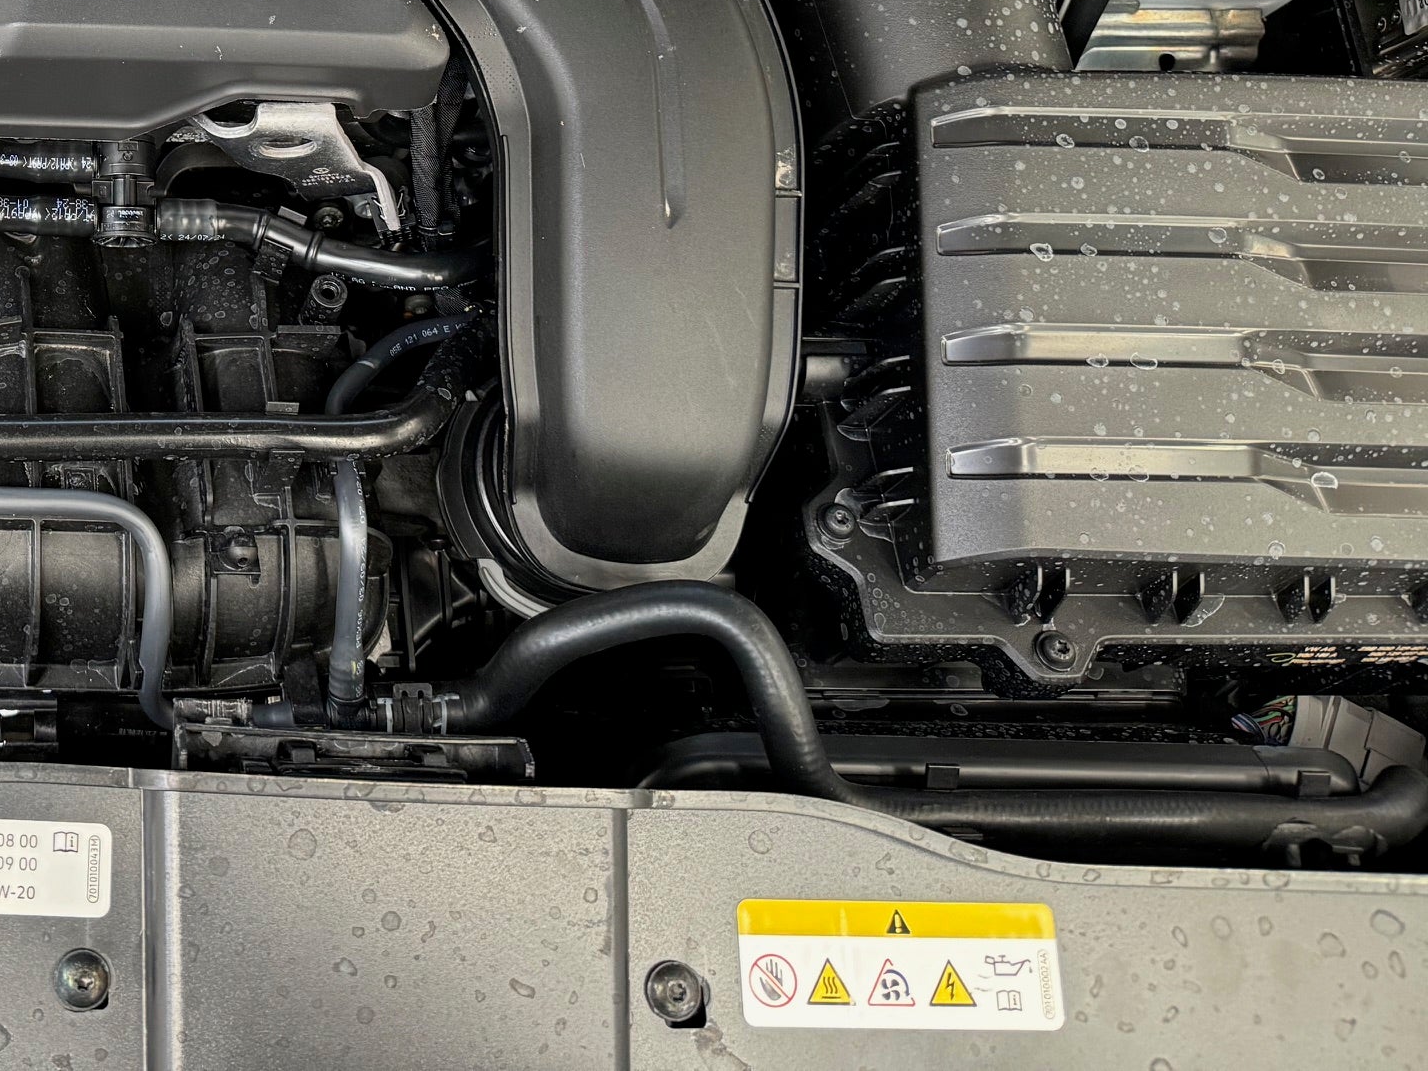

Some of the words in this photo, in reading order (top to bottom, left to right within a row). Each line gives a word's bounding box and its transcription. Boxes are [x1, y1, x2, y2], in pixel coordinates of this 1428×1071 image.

[404, 333, 419, 345] 121
[421, 327, 439, 338] 064
[19, 833, 39, 849] 00
[18, 856, 38, 872] 00
